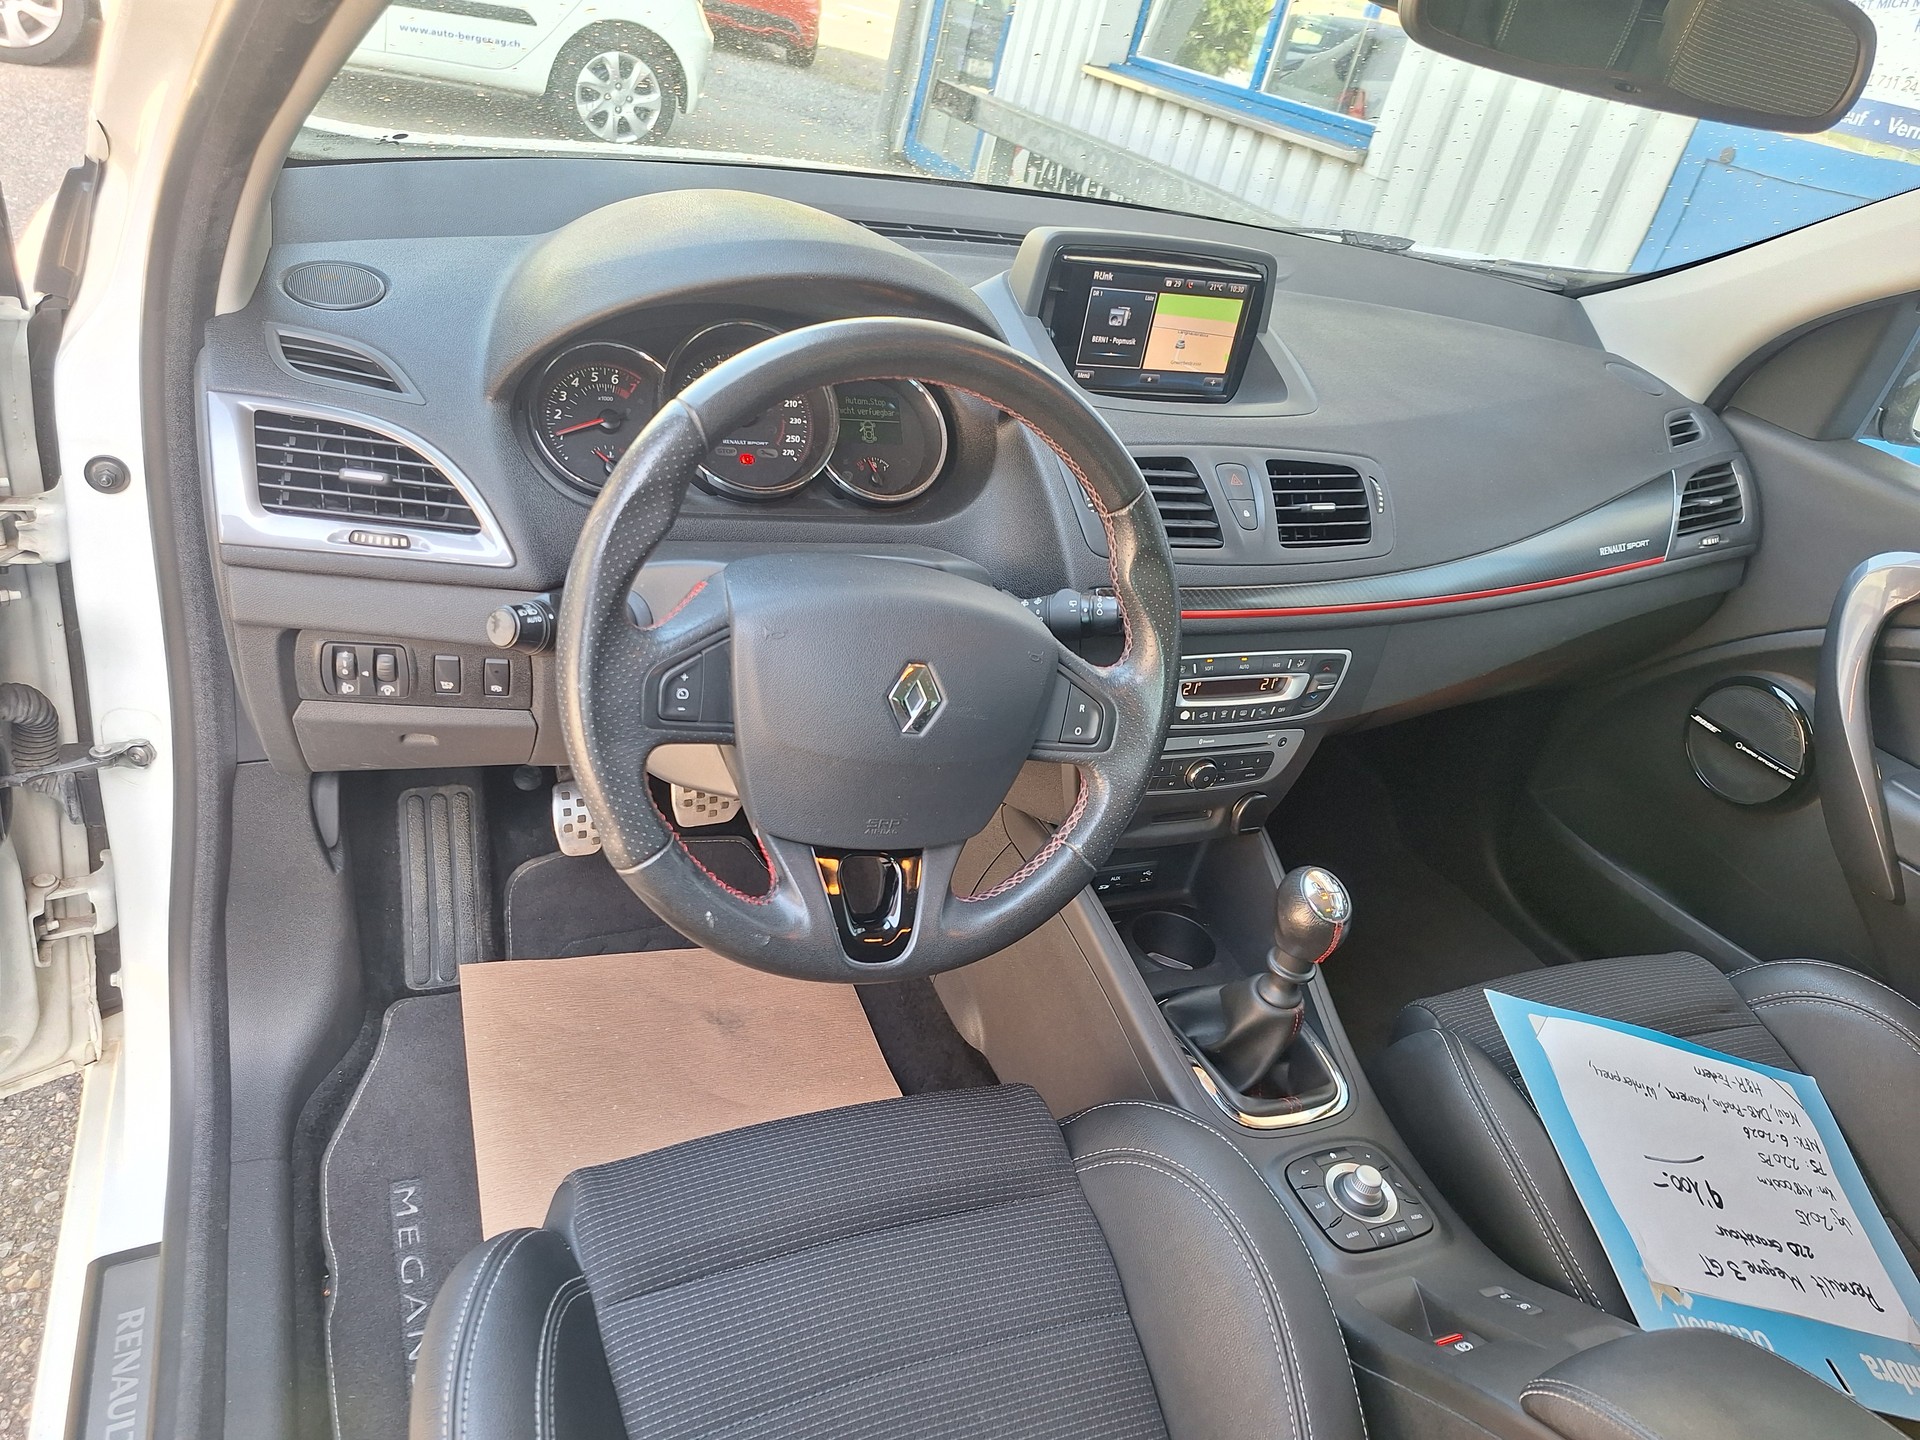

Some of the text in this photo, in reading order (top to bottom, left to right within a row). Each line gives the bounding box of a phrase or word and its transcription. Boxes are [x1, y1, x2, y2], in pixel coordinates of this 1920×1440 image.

[1229, 284, 1245, 293] 10:30
[1112, 337, 1137, 346] Popmusik
[571, 377, 580, 388] 4
[591, 372, 599, 383] 5
[611, 374, 619, 384] 6
[629, 383, 638, 393] 7
[559, 391, 567, 401] 3
[784, 400, 798, 408] 210
[554, 409, 562, 420] 2
[857, 408, 895, 419] verfuegbar
[785, 435, 800, 443] 250
[782, 449, 795, 457] 270
[1599, 539, 1650, 557] RENAULT SPORT
[527, 616, 543, 624] AUTO
[1079, 704, 1085, 713] R
[1742, 1127, 1789, 1147] 6.2026
[1804, 1159, 1827, 1176] PS:
[1315, 1201, 1326, 1209] MAP
[1795, 1209, 1834, 1232] 2015
[1346, 1230, 1360, 1239] MENU
[1715, 1224, 1783, 1253] Grandtour
[393, 1186, 427, 1386] MEGAN
[1698, 1253, 1885, 1313] Renault Megane 3 GT
